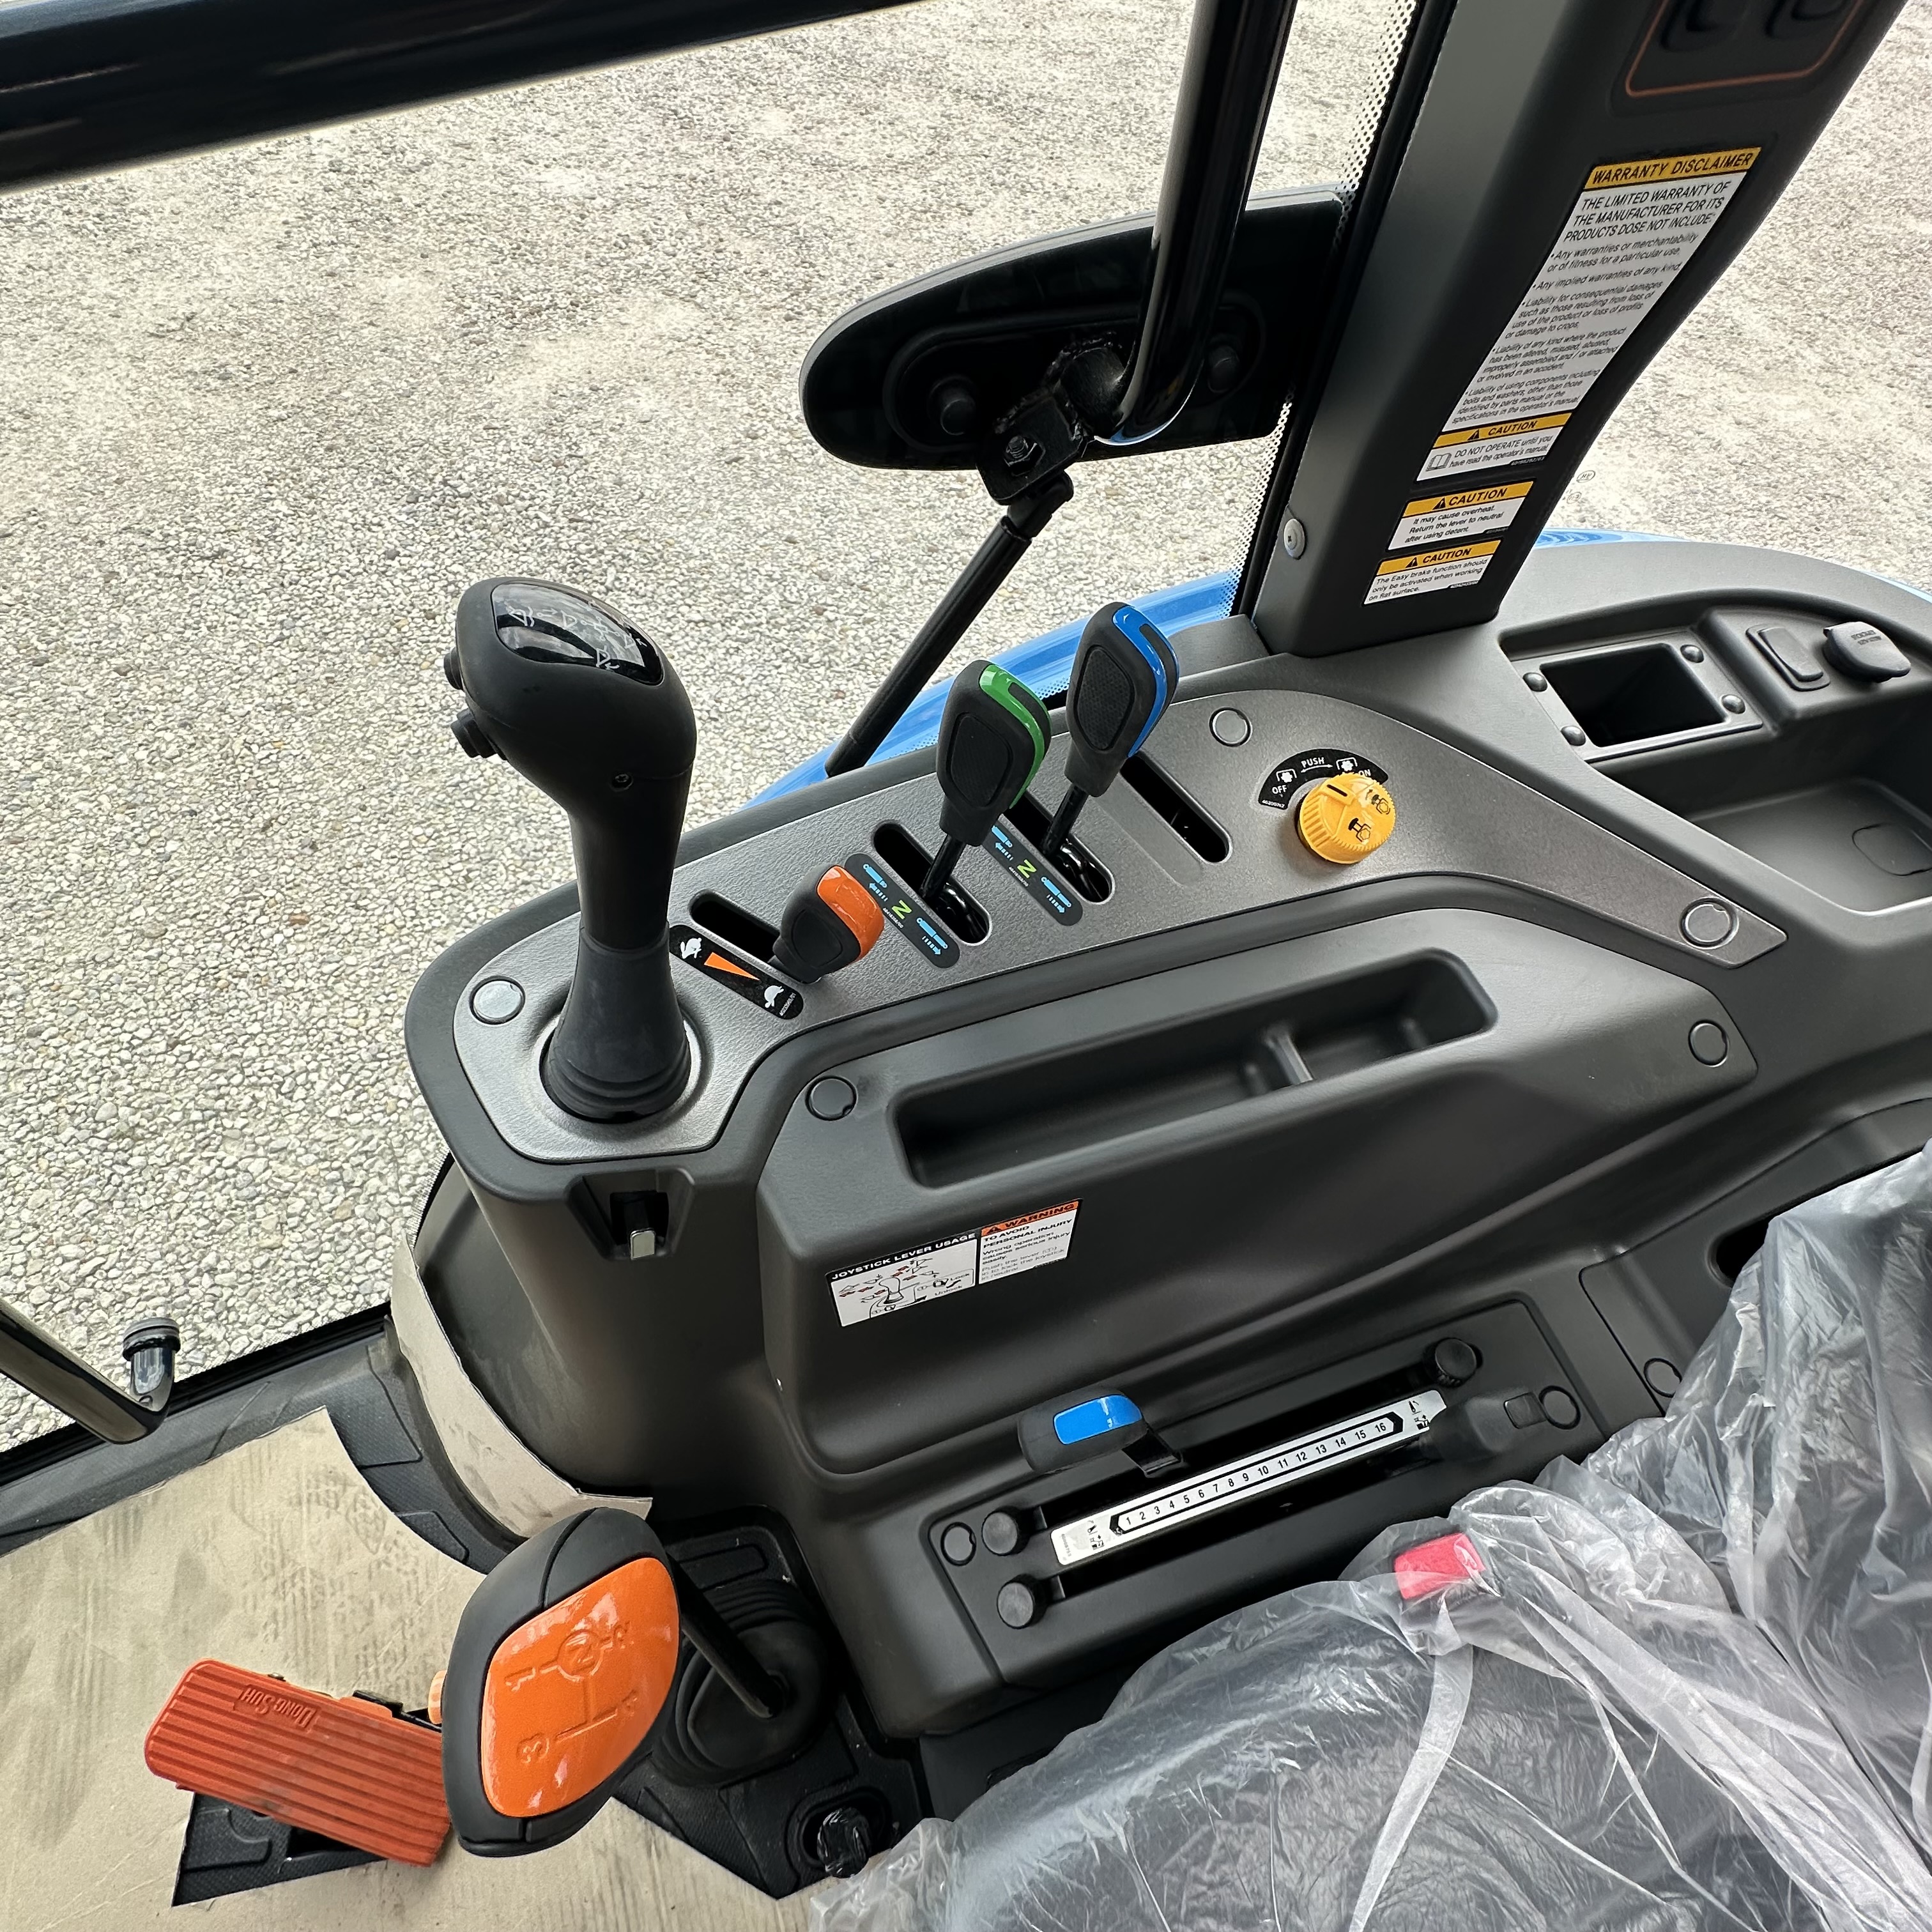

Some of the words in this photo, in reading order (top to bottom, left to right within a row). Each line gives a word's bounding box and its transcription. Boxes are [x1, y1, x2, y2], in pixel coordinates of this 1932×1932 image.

[1593, 162, 1669, 184] WARRANTY
[1671, 153, 1753, 174] DISCLAIMER
[1581, 196, 1605, 211] THE
[1604, 191, 1650, 208] LIMITED
[1650, 183, 1713, 201] WARRANTY
[1713, 180, 1731, 194] OF
[1573, 213, 1597, 227] THE
[1595, 202, 1683, 224] MANUFACTURER
[1682, 199, 1706, 213] FOR
[1705, 196, 1725, 210] ITS
[1563, 224, 1618, 241] PRODUCTS
[1617, 220, 1648, 235] DOSE
[1646, 218, 1670, 231] NOT
[1553, 250, 1573, 260] Any
[1574, 244, 1620, 257] warranties
[1620, 242, 1632, 251] or
[1632, 233, 1698, 249] merchantability
[1547, 264, 1558, 273] or
[1558, 260, 1570, 271] of
[1568, 258, 1598, 269] fitness
[1598, 256, 1613, 264] for
[1611, 255, 1620, 263] a
[1618, 249, 1663, 264] particular
[1535, 281, 1554, 290] Any
[1554, 275, 1589, 288] implied
[1588, 270, 1633, 282] warranties
[1633, 266, 1645, 277] of
[1643, 266, 1660, 275] any
[1518, 307, 1539, 318] such
[1538, 307, 1550, 315] as
[1550, 303, 1574, 312] those
[1573, 298, 1609, 309] resulting
[1608, 295, 1627, 304] from
[1627, 293, 1644, 302] loss
[1644, 290, 1655, 300] of
[1525, 295, 1558, 307] Liability
[1557, 293, 1570, 302] for
[1570, 285, 1627, 300] consequential
[1626, 281, 1663, 293] damages
[1512, 320, 1527, 329] use
[1527, 317, 1538, 326] of
[1536, 316, 1551, 325] the
[1549, 310, 1583, 324] product
[1592, 307, 1609, 316] loss
[1609, 304, 1620, 314] of
[1616, 302, 1643, 313] profits
[1495, 342, 1523, 354] Liability
[1522, 341, 1533, 349] of
[1531, 340, 1547, 348] any
[1597, 326, 1627, 339] product
[1505, 331, 1515, 339] or
[1514, 326, 1547, 337] damage
[1480, 393, 1497, 402] and
[1527, 385, 1547, 394] other
[1546, 383, 1563, 391] than
[1487, 420, 1538, 436] CAUTION
[1453, 448, 1468, 458] DO
[1467, 445, 1486, 456] NOT
[1485, 439, 1522, 452] OPERATE
[1521, 436, 1539, 446] until
[1537, 435, 1553, 445] you
[1448, 459, 1466, 468] have
[1466, 455, 1482, 464] read
[1448, 487, 1507, 506] CAUTION
[1409, 525, 1434, 534] Return
[1477, 511, 1504, 521] neutral
[1438, 512, 1460, 521] cause
[1461, 505, 1495, 516] overheat.
[1423, 531, 1444, 540] using
[1422, 548, 1472, 564] CAUTION
[1399, 576, 1433, 587] activated
[1434, 572, 1453, 581] when
[1454, 567, 1483, 576] working
[1409, 569, 1431, 578] brake
[1432, 564, 1462, 573] function
[1462, 558, 1488, 568] should
[1392, 586, 1420, 596] surface.
[1301, 757, 1325, 768] PUSH
[1358, 769, 1371, 777] ON
[1271, 785, 1287, 794] OFF
[1016, 859, 1037, 878] N
[891, 900, 912, 919] N
[1005, 1204, 1074, 1227] WARNING
[983, 1230, 1035, 1248] PERSONAL
[1038, 1218, 1072, 1232] INJURY
[999, 1225, 1029, 1238] AVOID
[1048, 1231, 1070, 1241] injury
[983, 1245, 1011, 1255] Wrong
[1013, 1232, 1054, 1246] operation
[832, 1258, 891, 1279] JOYSTICK
[894, 1246, 931, 1261] LEVER
[935, 1232, 975, 1248] USAGE
[1139, 1512, 1146, 1521] 2
[1154, 1506, 1160, 1514] 3
[1169, 1500, 1175, 1509] 4
[1183, 1495, 1190, 1503] 5
[1198, 1489, 1204, 1498] 6
[1213, 1483, 1218, 1492] 7
[1228, 1478, 1234, 1487] 8
[1242, 1473, 1249, 1482] 9
[1257, 1466, 1269, 1476] 10
[1278, 1458, 1289, 1469] 11
[1296, 1452, 1308, 1462] 12
[1315, 1444, 1327, 1455] 13
[1335, 1437, 1347, 1448] 14
[1354, 1430, 1367, 1441] 15
[1375, 1422, 1386, 1433] 16
[505, 1666, 536, 1692] 1
[516, 1731, 550, 1764] 3
